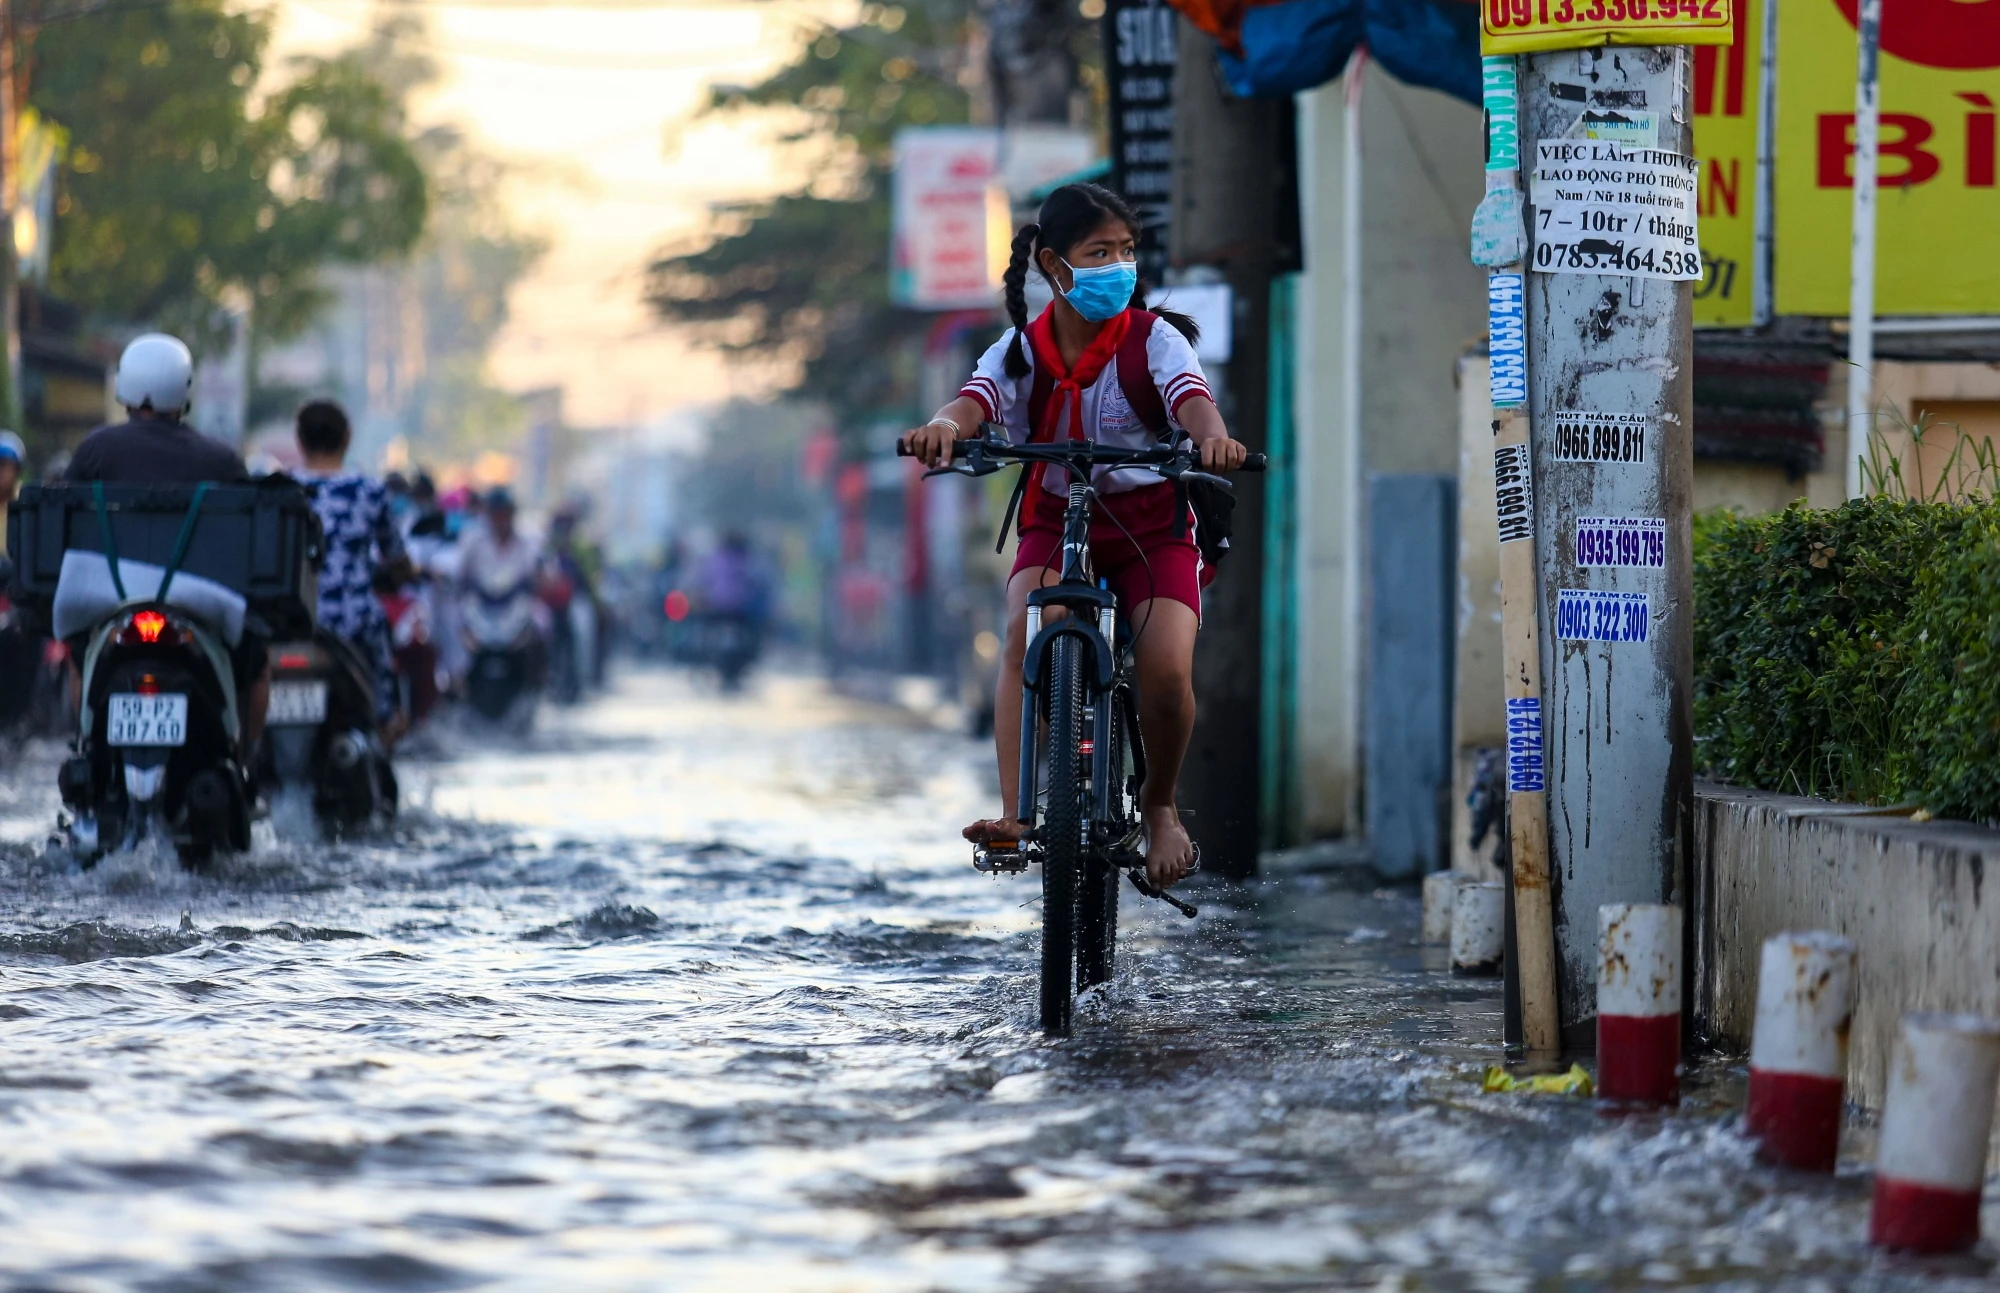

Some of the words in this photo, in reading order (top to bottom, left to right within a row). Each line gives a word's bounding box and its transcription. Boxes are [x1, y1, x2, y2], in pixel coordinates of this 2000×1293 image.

[1540, 144, 1586, 163] VIỆC
[1591, 142, 1635, 163] LÀM
[1541, 169, 1573, 182] LAO
[1577, 168, 1622, 185] ĐỘNG
[1659, 173, 1694, 192] THÔNG
[1555, 189, 1583, 201] Nam
[1586, 189, 1591, 201] /
[1594, 189, 1615, 201] Nữ
[1618, 191, 1631, 203] 18
[1635, 191, 1656, 205] tuổi
[1658, 194, 1673, 208] trở
[1674, 198, 1684, 210] lên
[1539, 209, 1553, 230] 7
[1579, 210, 1628, 233] 10tr
[1633, 213, 1643, 234] /
[1648, 215, 1695, 246] tháng
[1489, 276, 1525, 400] 0933.833.446
[1556, 412, 1581, 420] HÚT
[1555, 424, 1645, 463] 0966.899.811
[1578, 517, 1605, 525] HÚT
[1577, 529, 1664, 567] 0935.199.795
[1558, 599, 1648, 643] 0903.322.300
[1508, 697, 1544, 792] 0918.12.12.16
